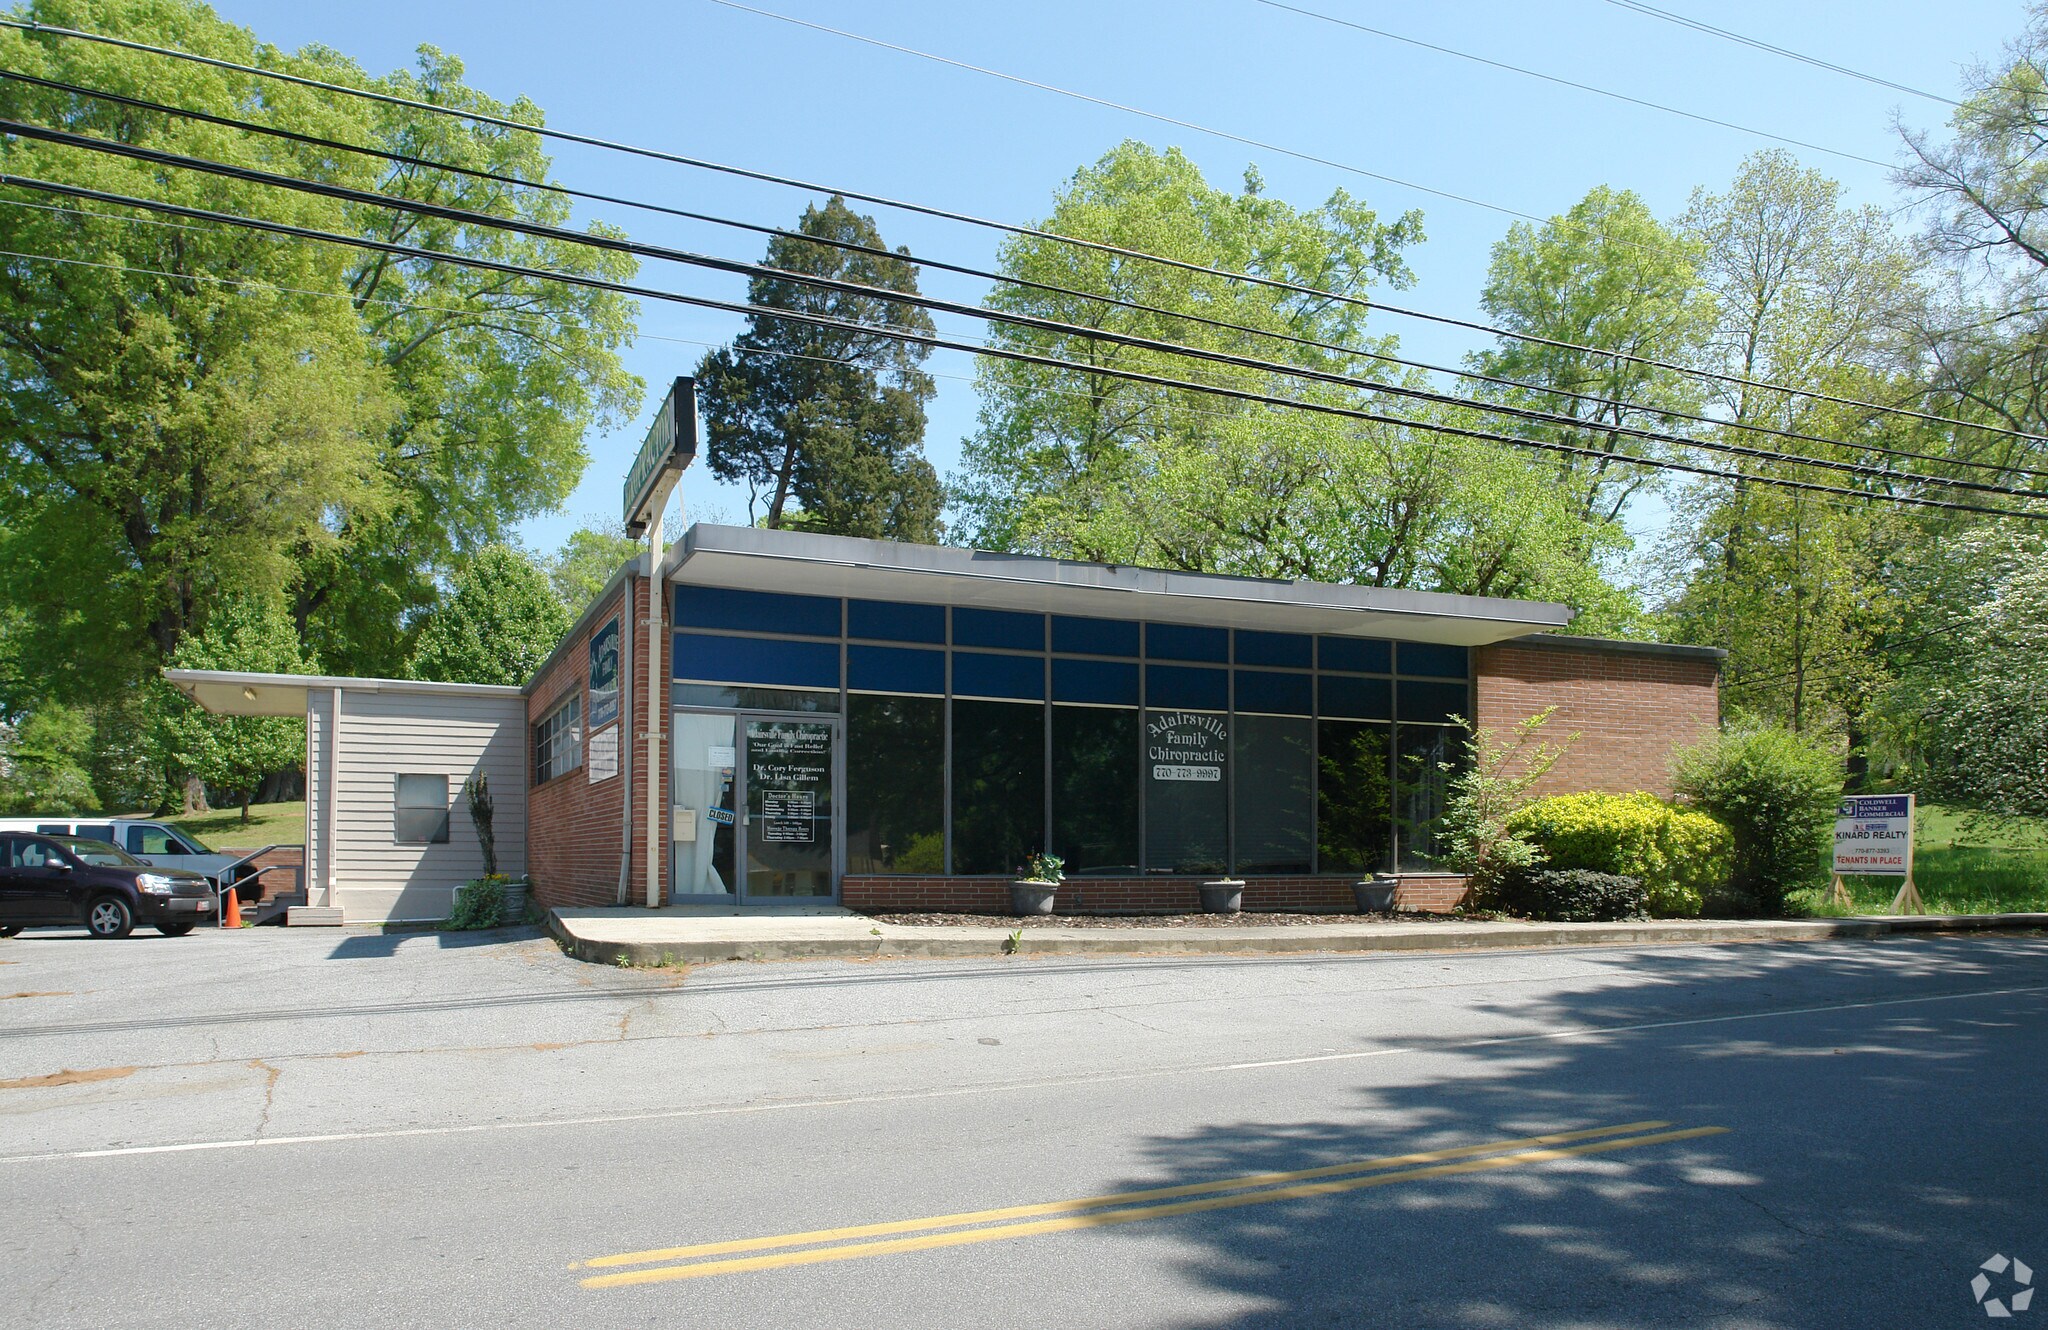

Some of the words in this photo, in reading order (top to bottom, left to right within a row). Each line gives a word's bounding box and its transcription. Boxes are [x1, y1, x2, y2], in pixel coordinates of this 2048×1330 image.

[1147, 712, 1227, 740] Adairsville
[796, 730, 828, 743] Chiropractic
[1166, 730, 1208, 748] Family
[1149, 746, 1224, 764] Chiropractic
[753, 763, 766, 771] Dr.
[768, 764, 786, 773] Cory
[788, 764, 825, 773] Ferguson
[1156, 767, 1218, 779] 770-773-9997
[709, 809, 733, 822] CLOSED
[1873, 831, 1907, 839] REALTY
